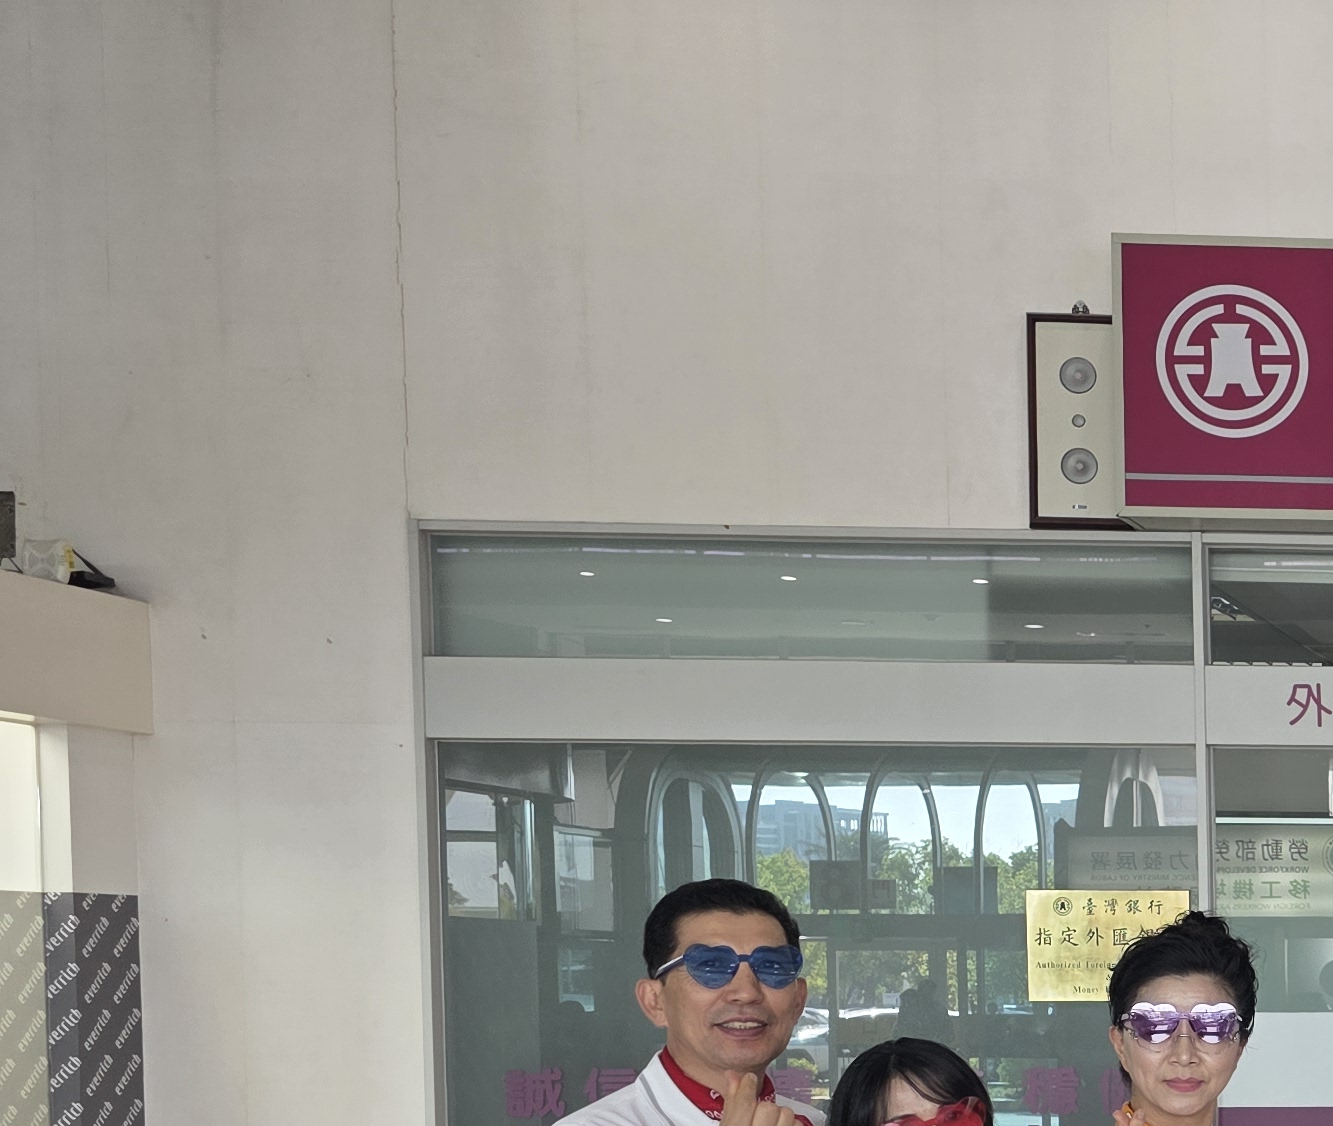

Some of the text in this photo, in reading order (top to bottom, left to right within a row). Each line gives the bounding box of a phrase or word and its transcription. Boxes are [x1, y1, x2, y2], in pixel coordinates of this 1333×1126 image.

[1082, 897, 1164, 916] 臺灣銀行
[46, 914, 80, 957] verrich
[48, 1008, 83, 1049] verrich
